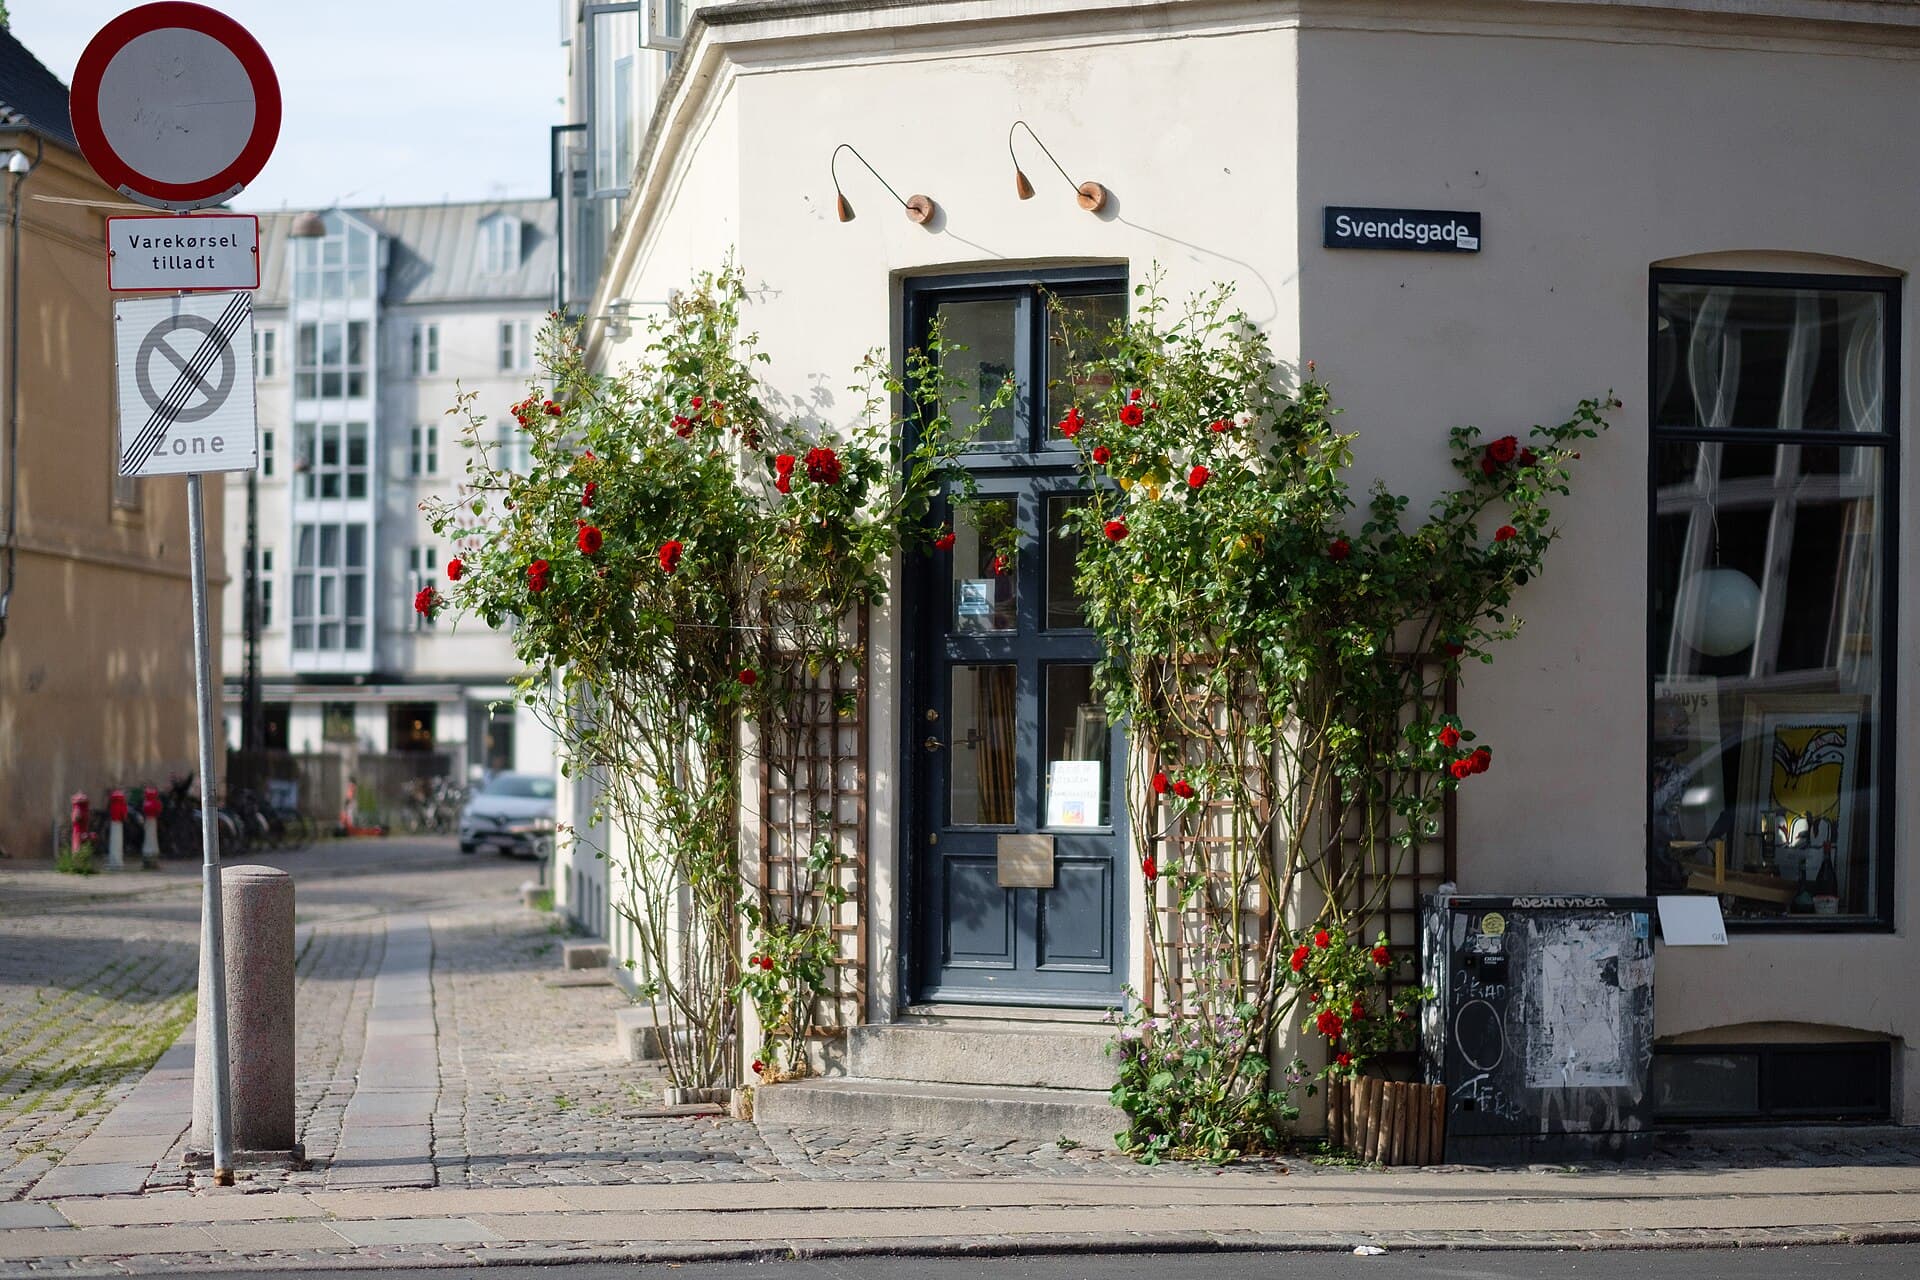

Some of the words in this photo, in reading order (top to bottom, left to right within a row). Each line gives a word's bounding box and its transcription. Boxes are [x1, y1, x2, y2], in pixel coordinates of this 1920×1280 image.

[1335, 215, 1469, 245] Svendsgade
[128, 233, 239, 250] Varekørsel
[152, 254, 217, 271] tilladt
[152, 433, 226, 458] Zone
